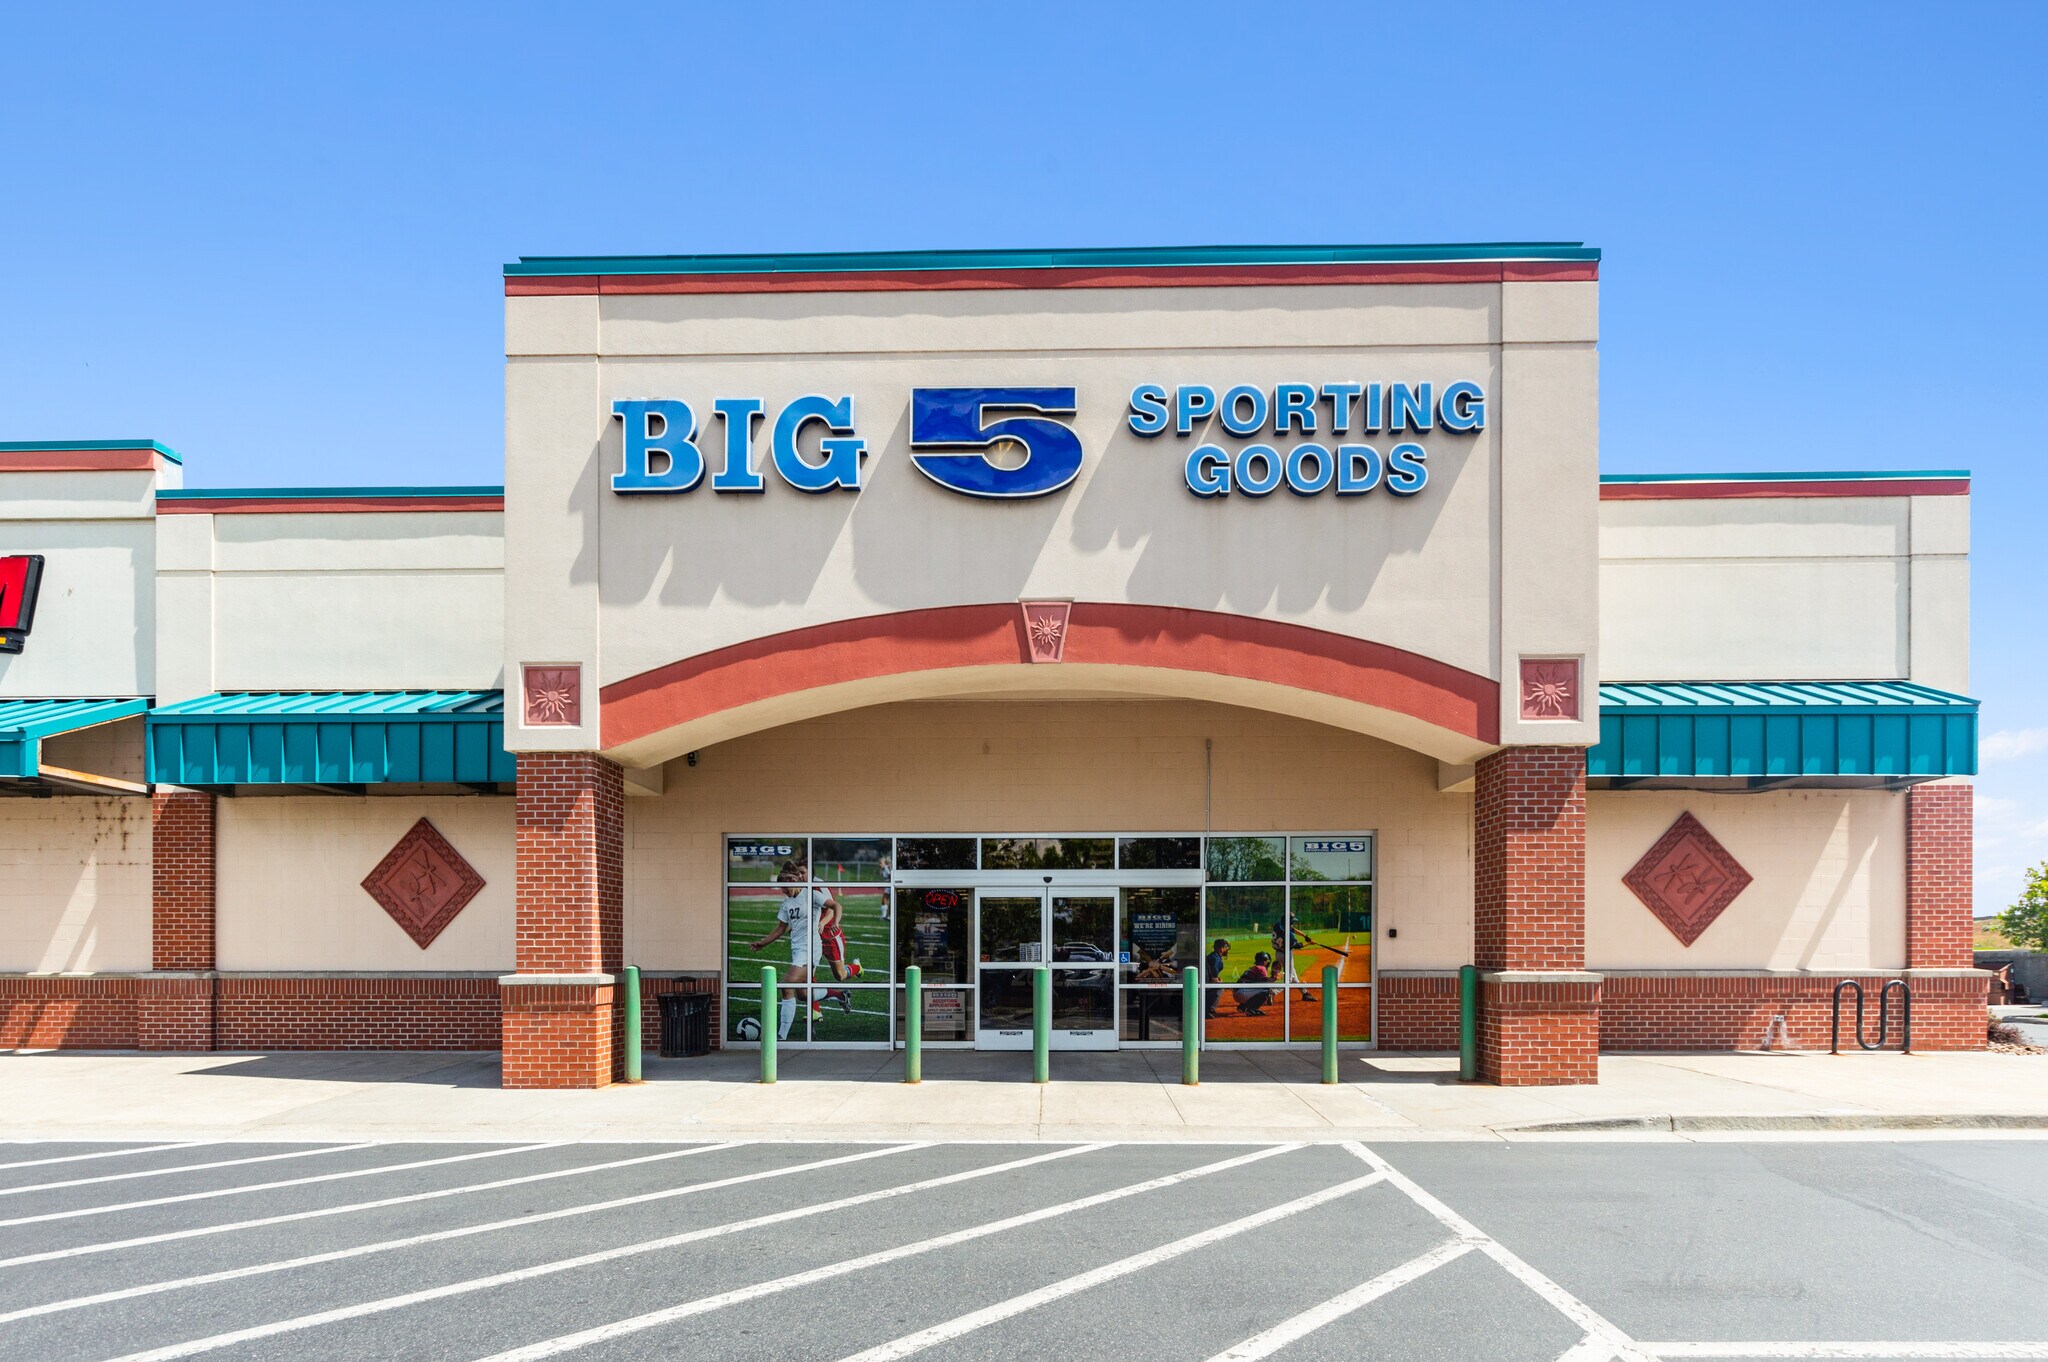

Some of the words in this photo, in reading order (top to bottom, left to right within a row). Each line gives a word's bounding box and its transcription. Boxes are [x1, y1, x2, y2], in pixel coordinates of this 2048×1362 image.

[1128, 380, 1487, 438] SPORTING
[610, 393, 868, 496] BIG
[909, 386, 1083, 499] 5
[1184, 442, 1430, 498] GOODS
[788, 907, 801, 920] 27
[925, 892, 959, 907] OPEN
